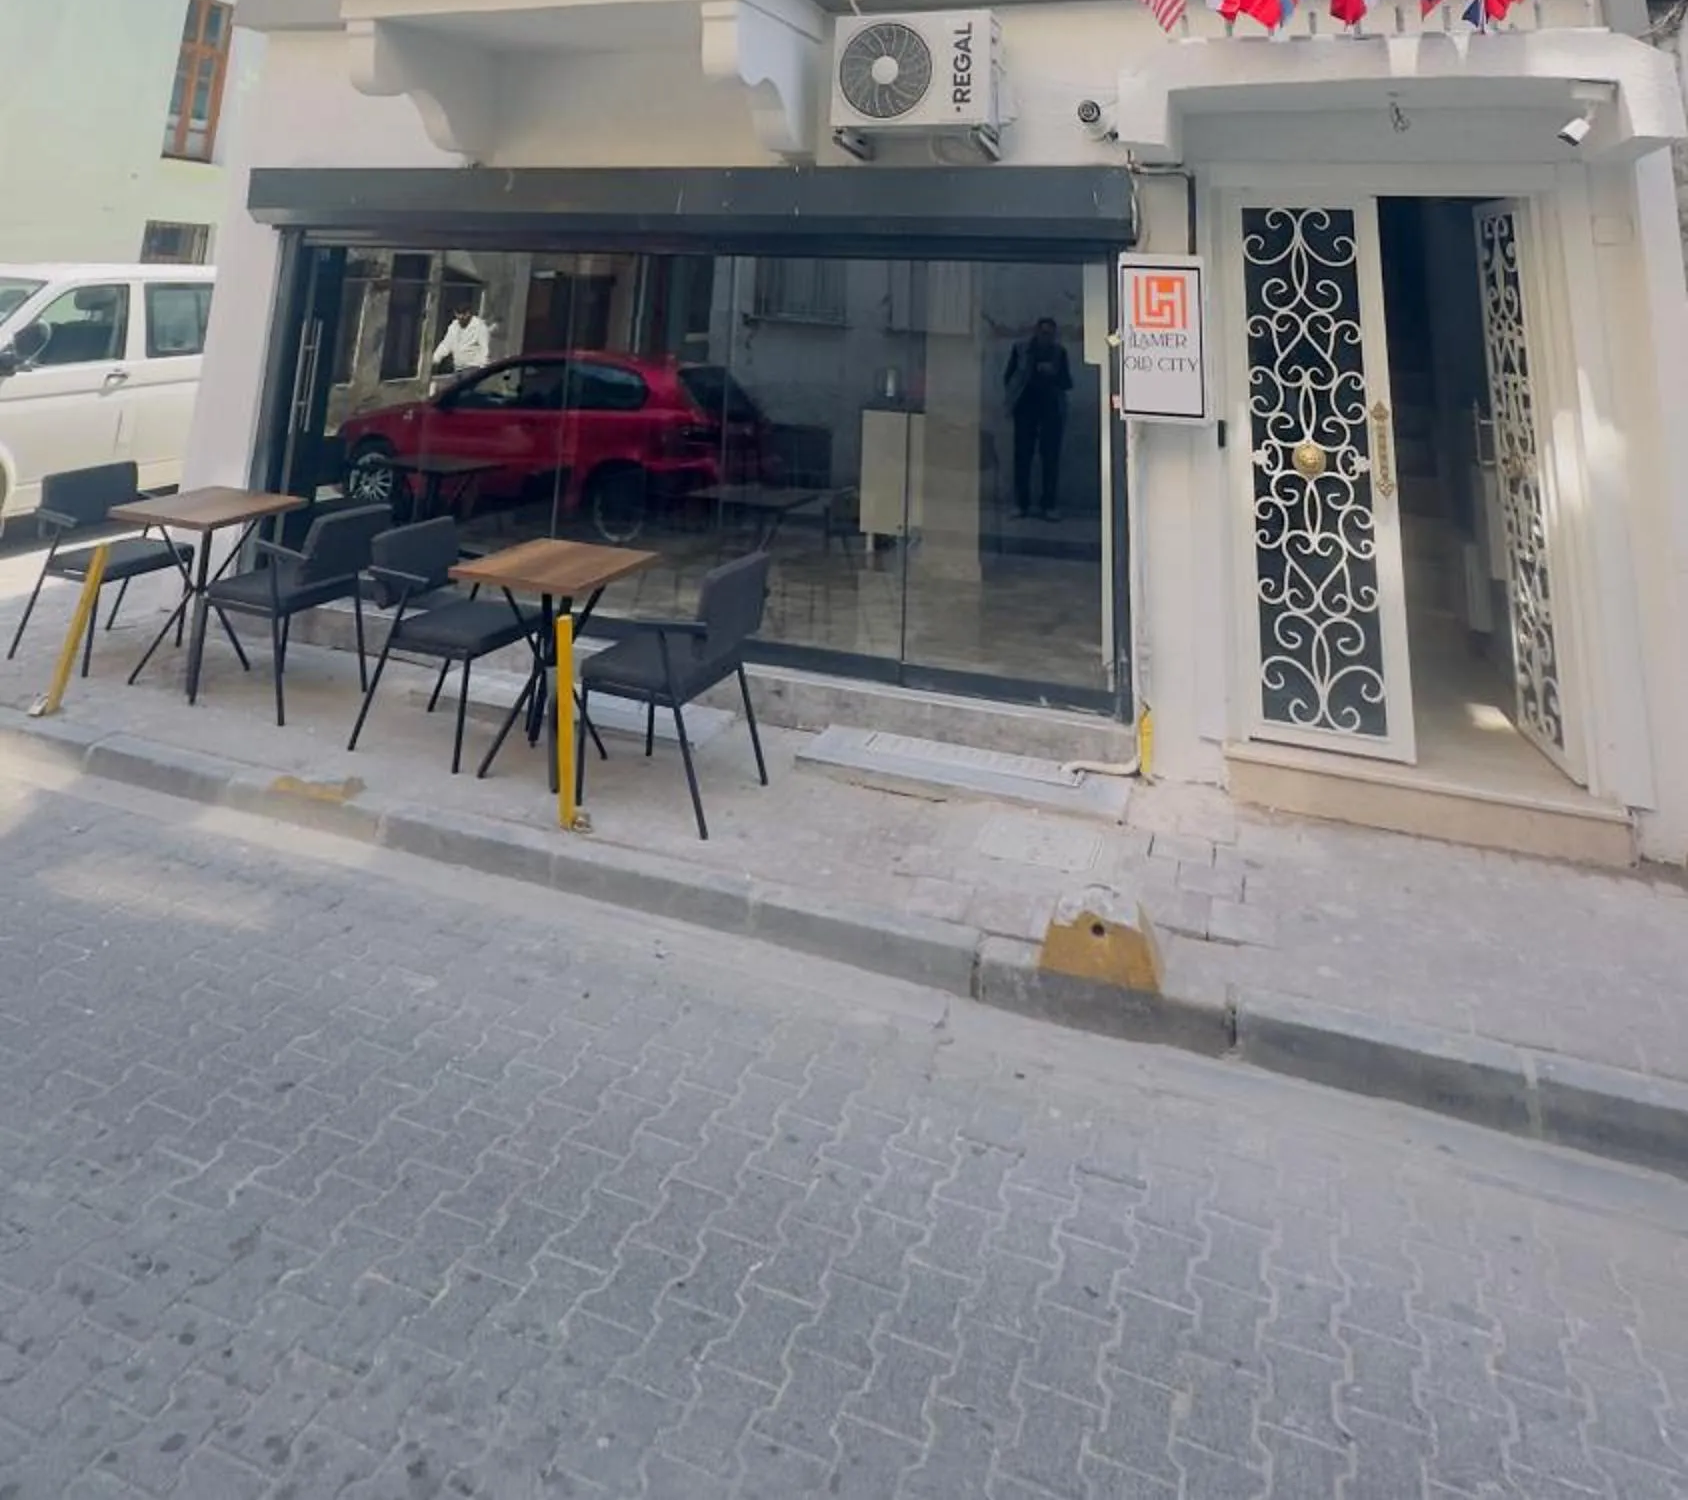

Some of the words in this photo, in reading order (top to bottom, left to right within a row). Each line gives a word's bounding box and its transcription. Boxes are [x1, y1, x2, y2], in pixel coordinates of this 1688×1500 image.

[953, 22, 973, 104] REGAL
[1125, 354, 1154, 372] OLD
[1157, 356, 1199, 373] CITY
